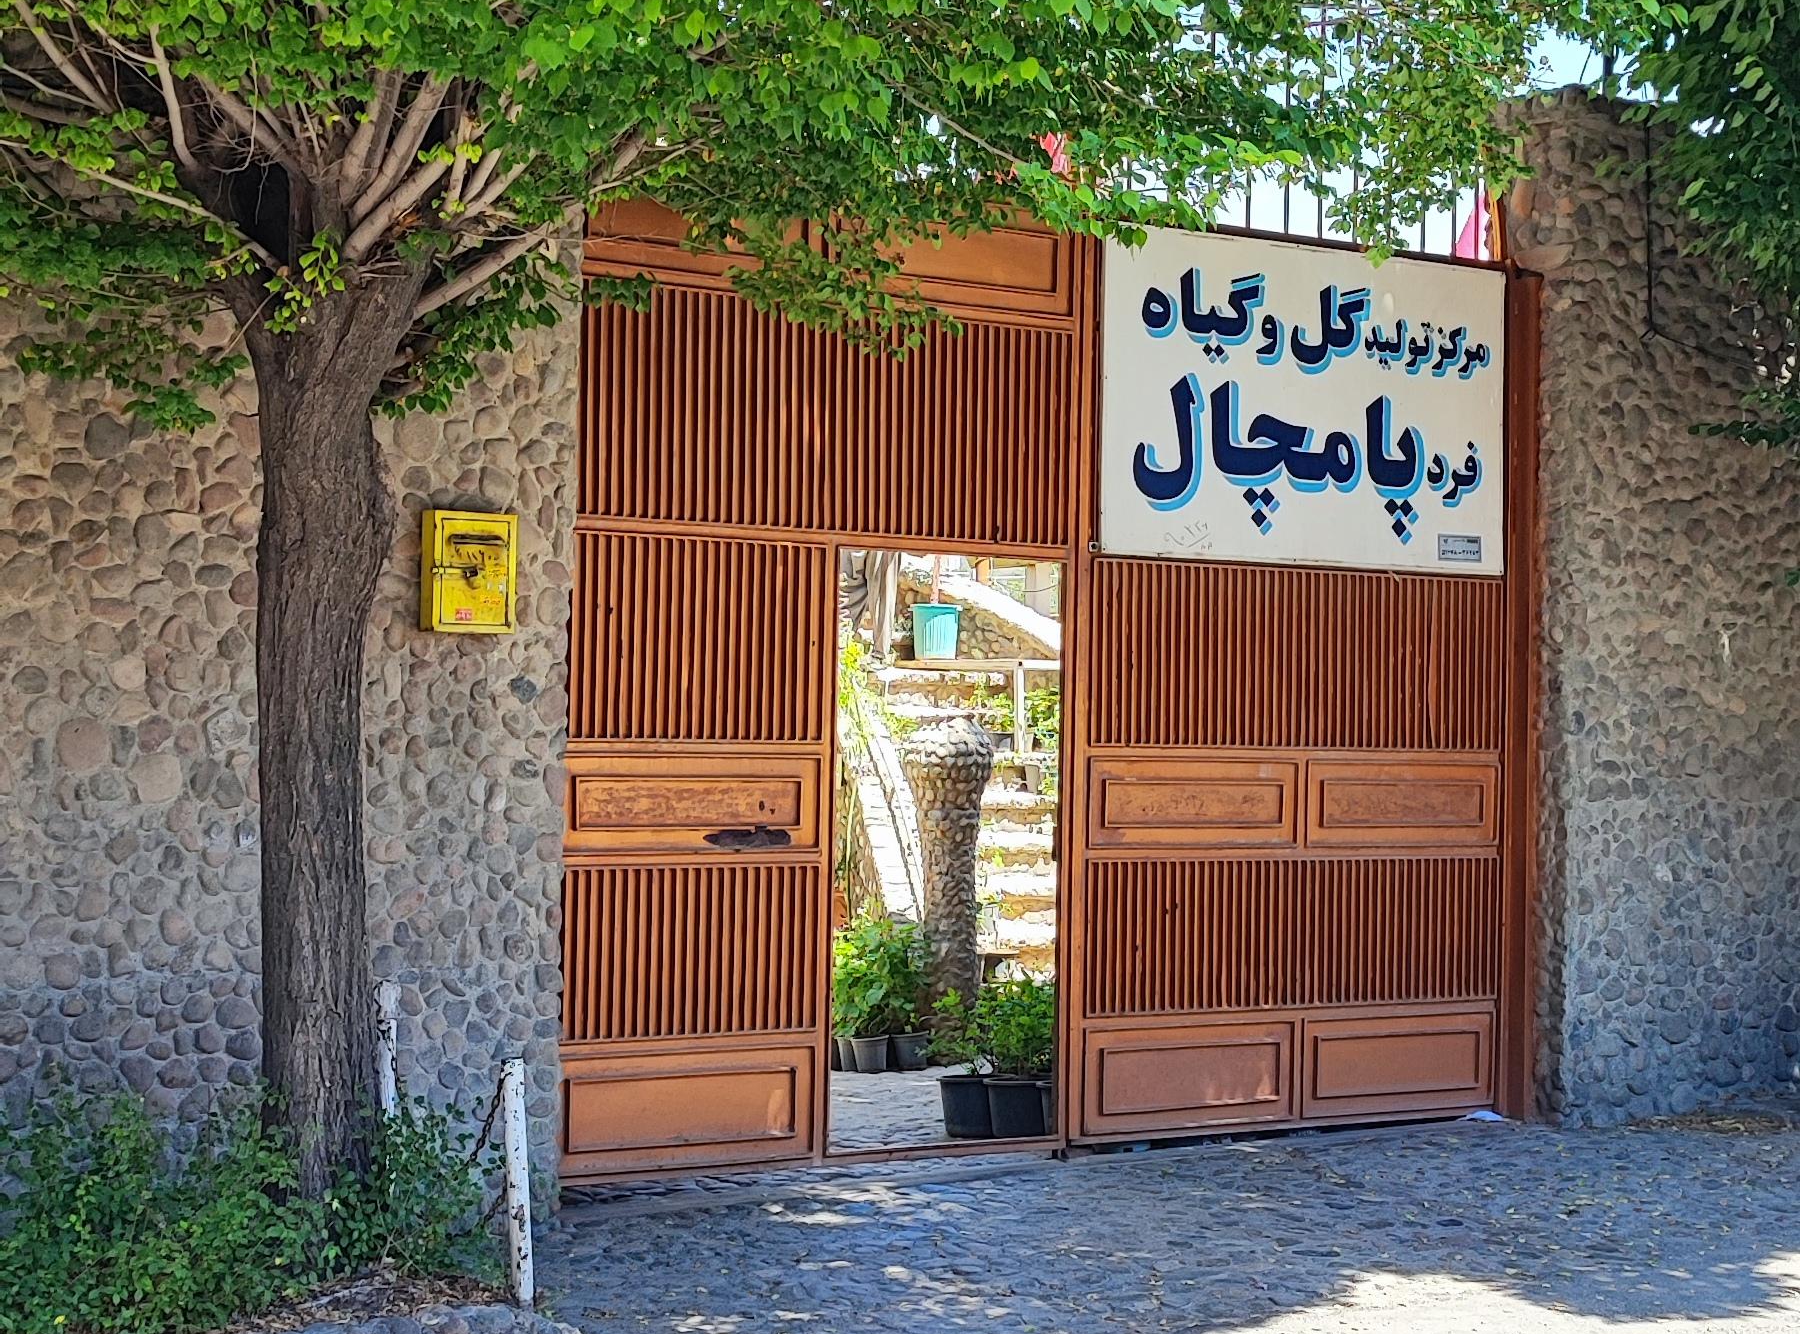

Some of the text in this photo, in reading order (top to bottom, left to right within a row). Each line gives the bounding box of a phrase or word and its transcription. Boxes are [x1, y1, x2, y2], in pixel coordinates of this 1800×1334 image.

[1141, 267, 1491, 380] مرکز تولید گل و گیاه
[1132, 372, 1482, 546] فرد پامچال
